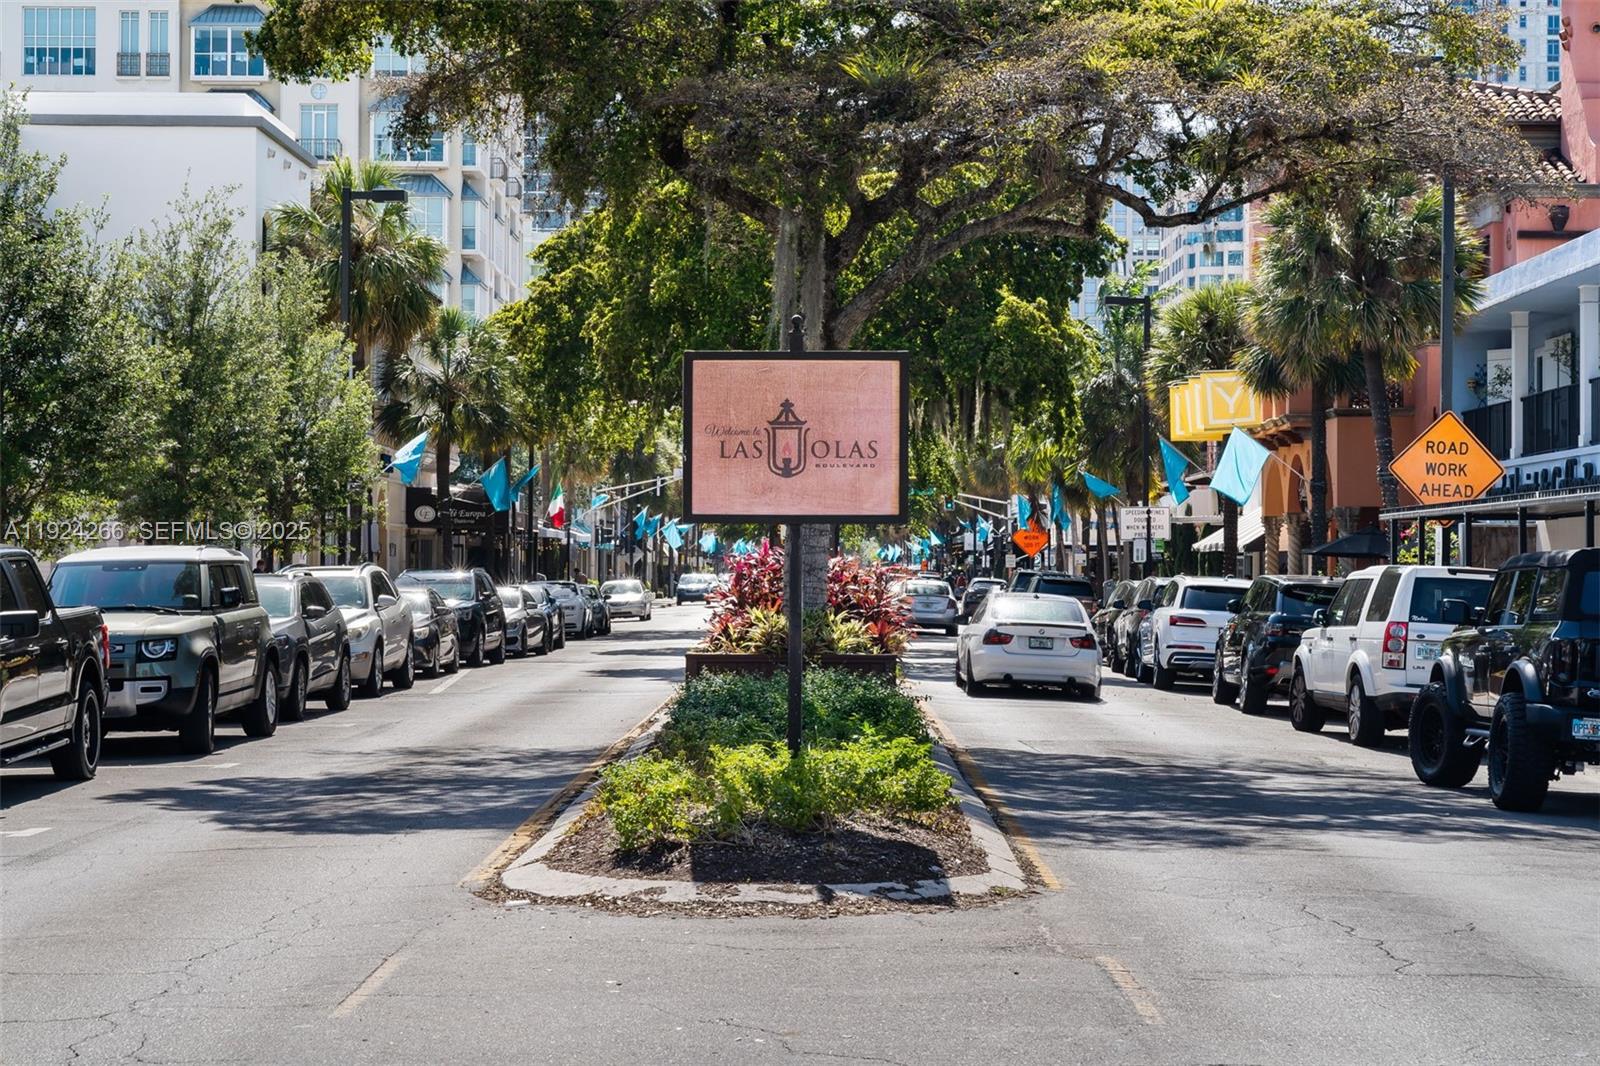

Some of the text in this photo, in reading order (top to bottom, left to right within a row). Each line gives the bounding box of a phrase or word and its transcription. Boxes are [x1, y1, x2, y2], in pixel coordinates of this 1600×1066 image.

[704, 424, 762, 439] Welcome to
[720, 439, 878, 459] LAS OLAS
[1425, 440, 1469, 455] ROAD
[1425, 462, 1468, 477] WORK
[1419, 483, 1474, 498] AHEAD
[459, 509, 486, 520] Europa
